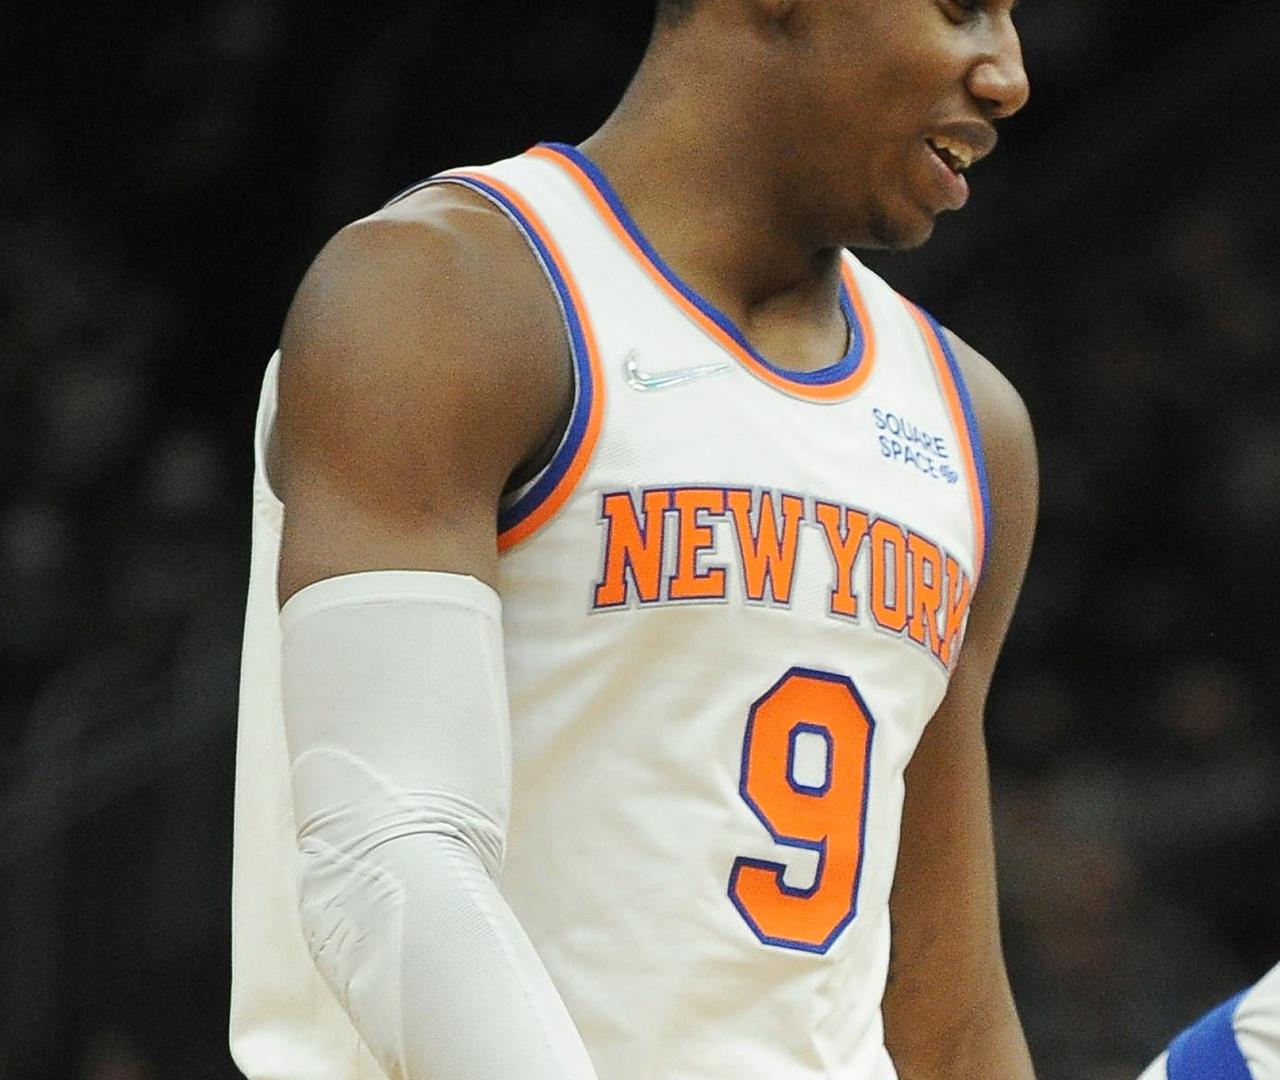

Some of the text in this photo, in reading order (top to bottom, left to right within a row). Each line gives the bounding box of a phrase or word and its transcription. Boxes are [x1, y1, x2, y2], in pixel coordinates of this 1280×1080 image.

[873, 408, 949, 459] SQUARE
[879, 434, 939, 479] SPACE
[592, 487, 970, 669] NEW YORK
[727, 666, 876, 955] 9
